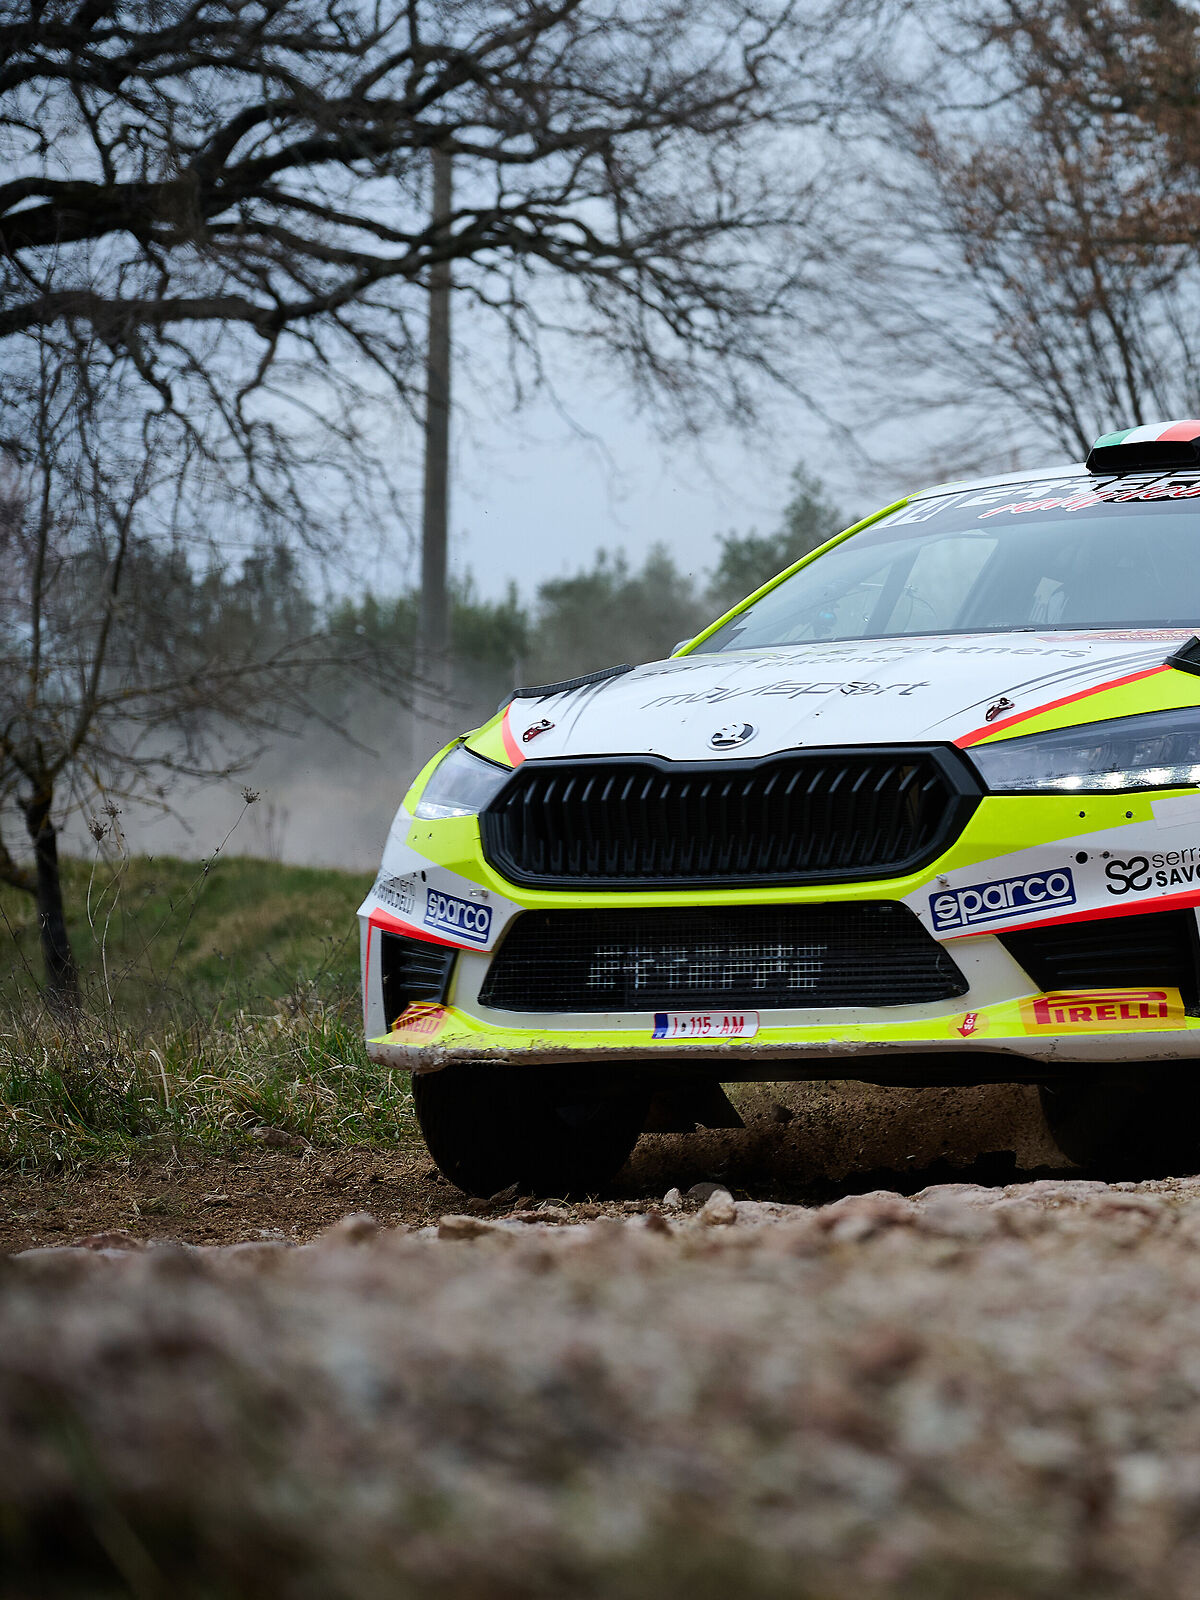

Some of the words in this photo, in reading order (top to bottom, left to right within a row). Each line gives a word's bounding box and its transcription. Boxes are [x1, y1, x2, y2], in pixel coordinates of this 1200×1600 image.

[873, 646, 1092, 658] Partners
[427, 892, 490, 932] sparco
[933, 874, 1070, 924] sparco
[963, 1013, 976, 1030] TOW
[1032, 991, 1168, 1025] PIRELLI
